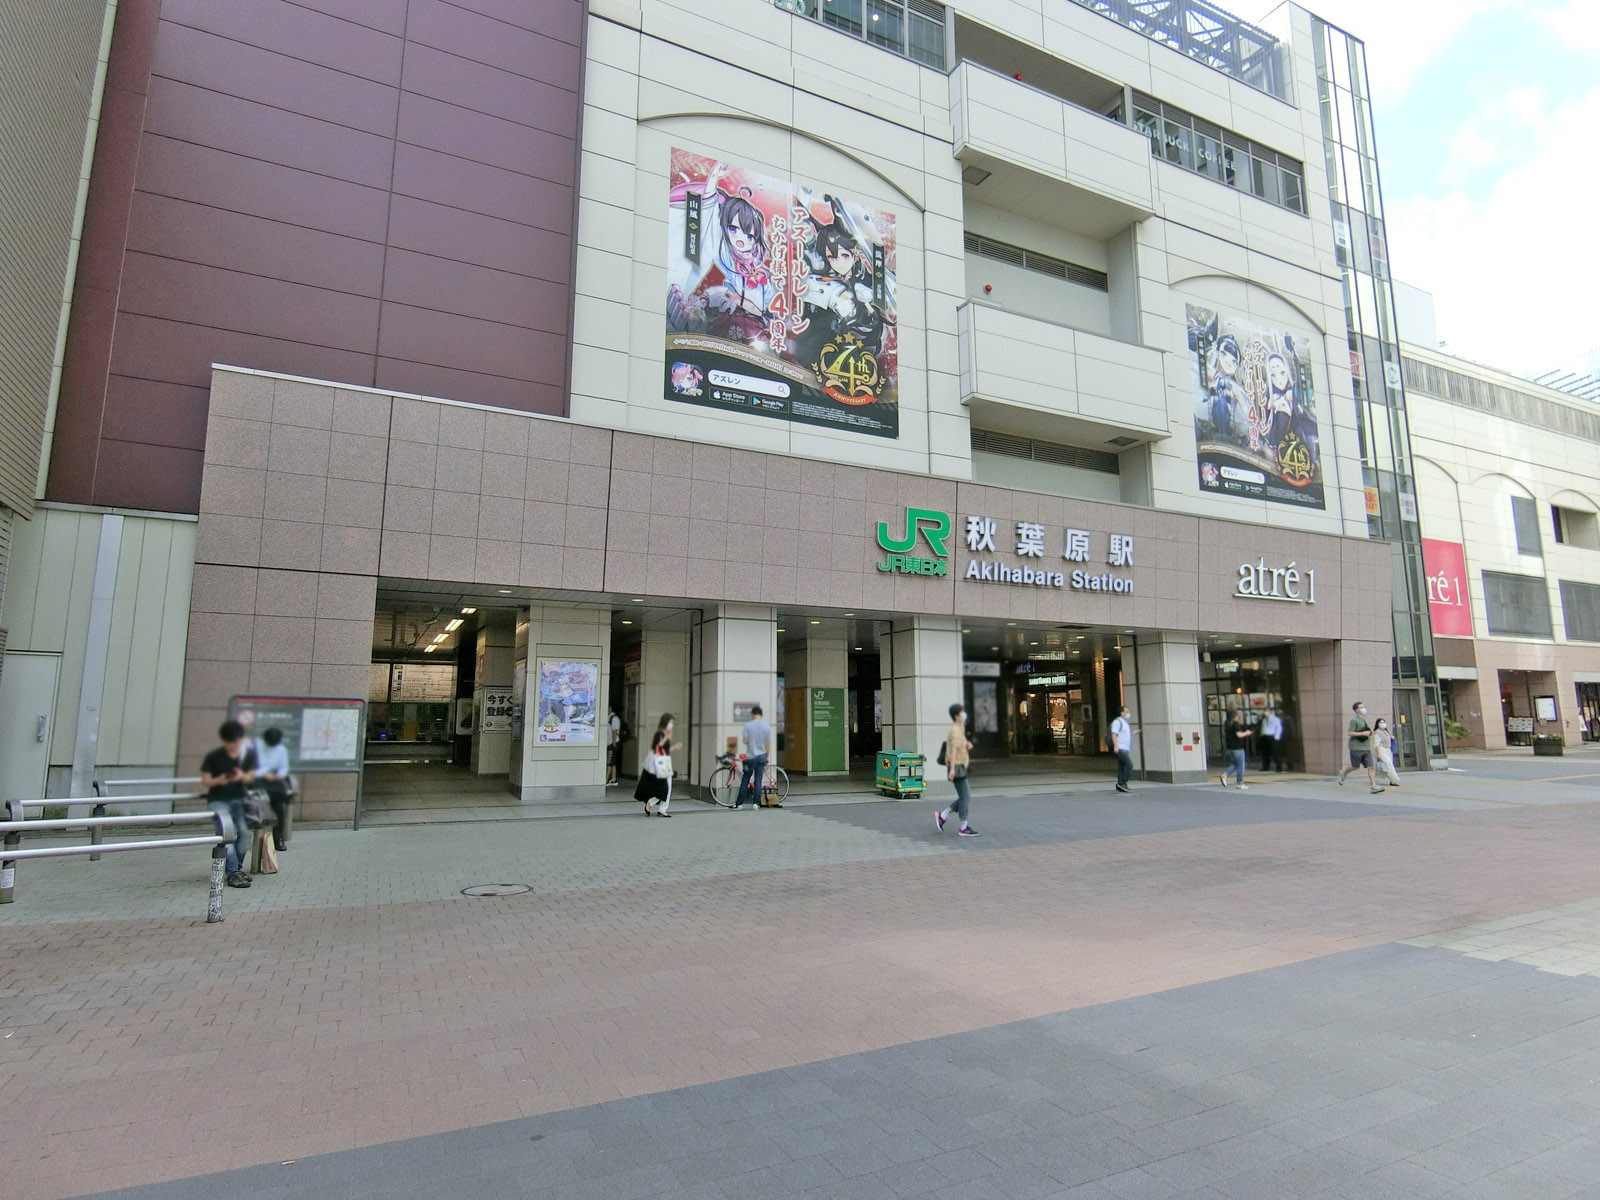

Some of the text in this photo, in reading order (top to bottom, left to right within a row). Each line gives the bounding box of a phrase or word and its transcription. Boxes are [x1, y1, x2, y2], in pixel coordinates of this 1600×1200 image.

[768, 214, 789, 353] おかげ様で4周年
[792, 207, 811, 334] アズールレーン
[712, 373, 741, 385] アズレン
[1252, 340, 1270, 436] アズールレーン
[877, 507, 951, 557] JR
[966, 515, 1134, 567] 秋葉原駅
[878, 554, 949, 577] JR東日本
[966, 559, 1134, 593] Akihabara Station
[1238, 556, 1301, 599] atré
